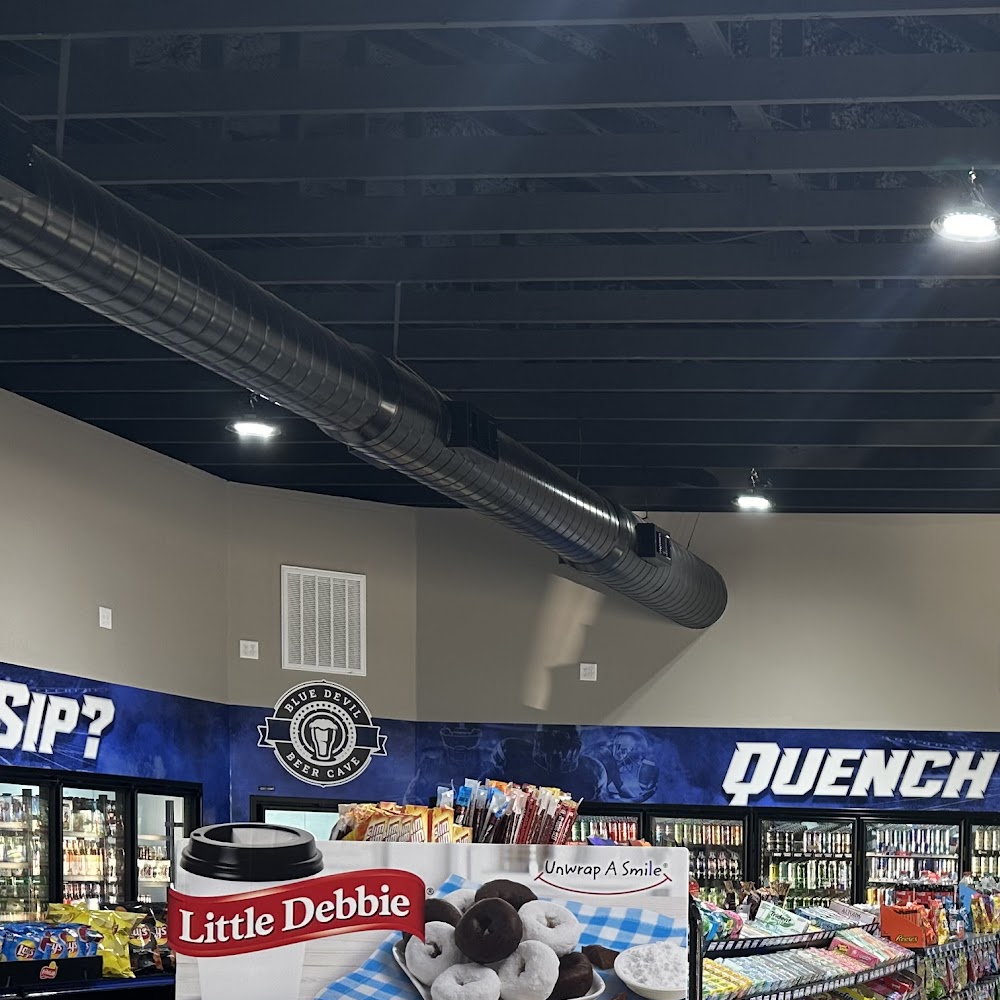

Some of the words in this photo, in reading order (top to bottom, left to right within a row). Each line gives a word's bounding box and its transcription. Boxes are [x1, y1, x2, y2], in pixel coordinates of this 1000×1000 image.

[0, 679, 116, 760] SIP?
[284, 689, 317, 713] BLUE
[324, 689, 361, 719] DEVIL
[286, 752, 320, 778] BEER
[327, 756, 361, 778] CAVE
[721, 741, 1000, 806] QUENCH
[545, 860, 601, 880] Unwrap
[604, 861, 617, 876] A
[622, 860, 662, 877] Smile
[178, 906, 275, 944] Little
[281, 884, 410, 932] Debbie
